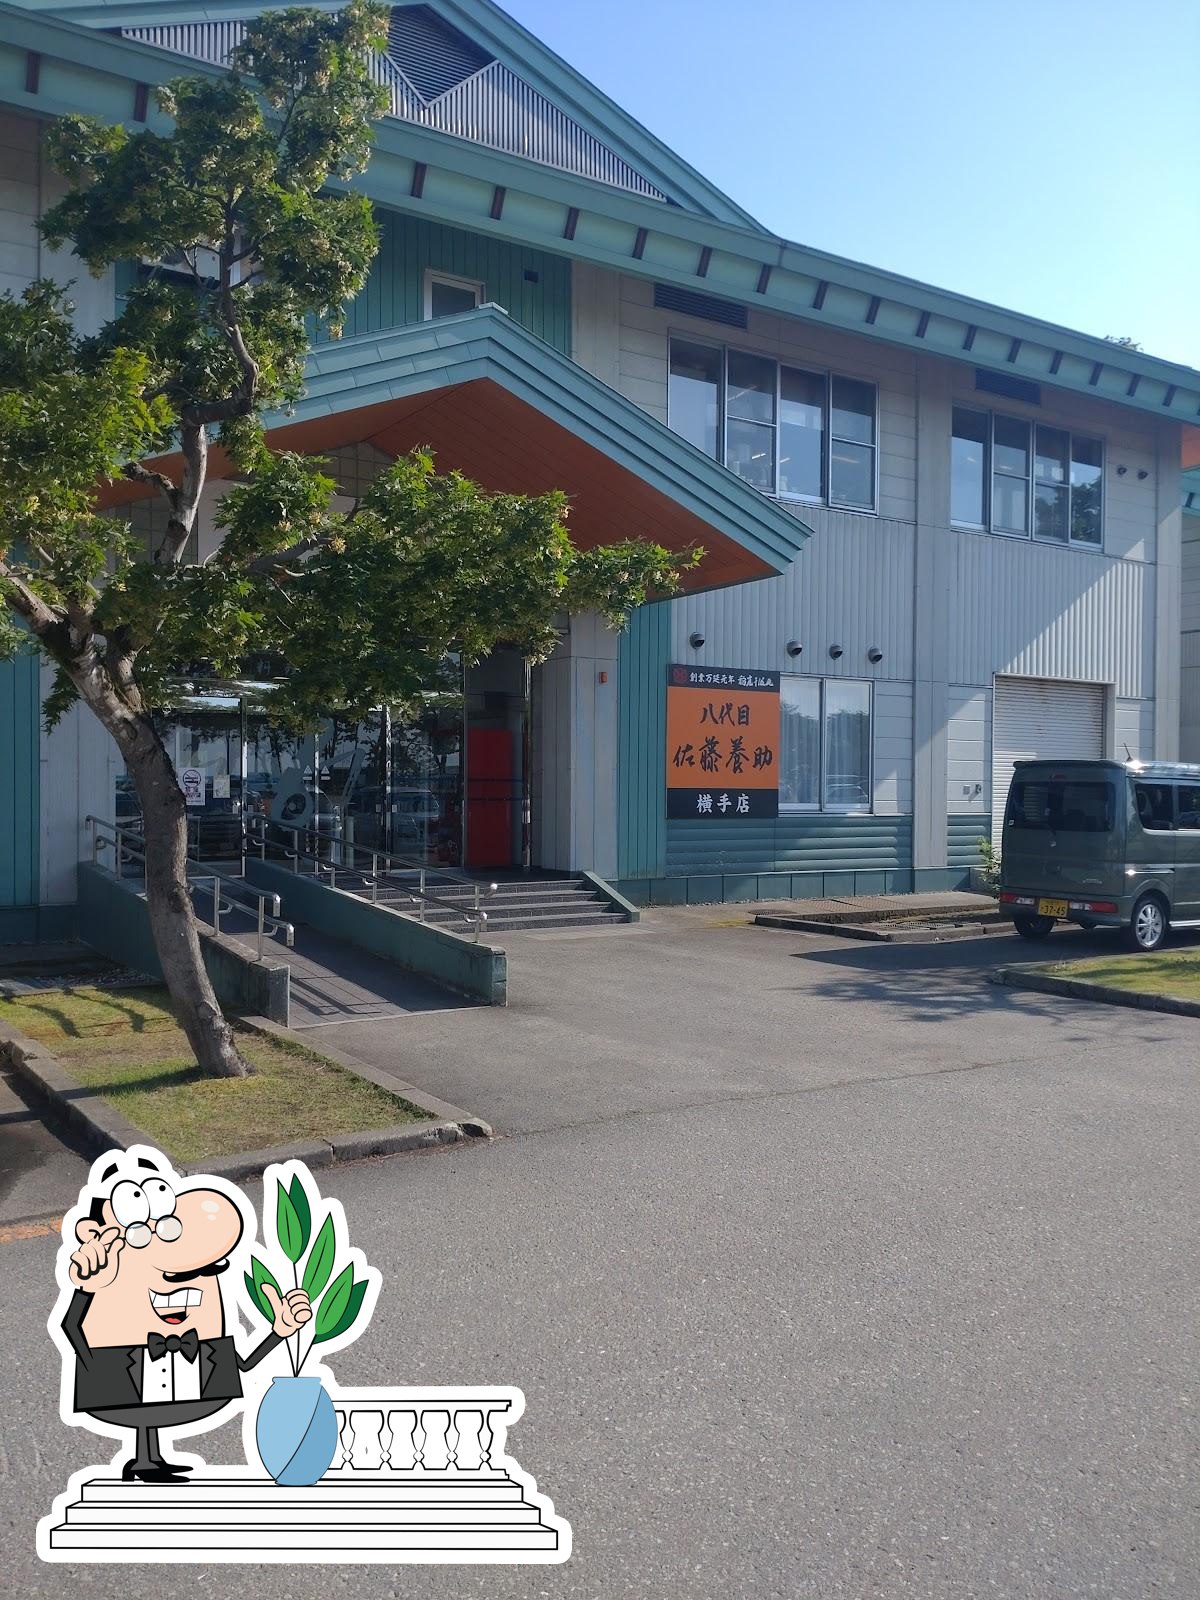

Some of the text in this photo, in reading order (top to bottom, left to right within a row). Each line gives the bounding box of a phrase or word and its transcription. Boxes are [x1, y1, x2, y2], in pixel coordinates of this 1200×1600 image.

[699, 702, 750, 727] 八代目
[672, 735, 773, 774] 佐藤養助
[696, 793, 751, 814] 横手店
